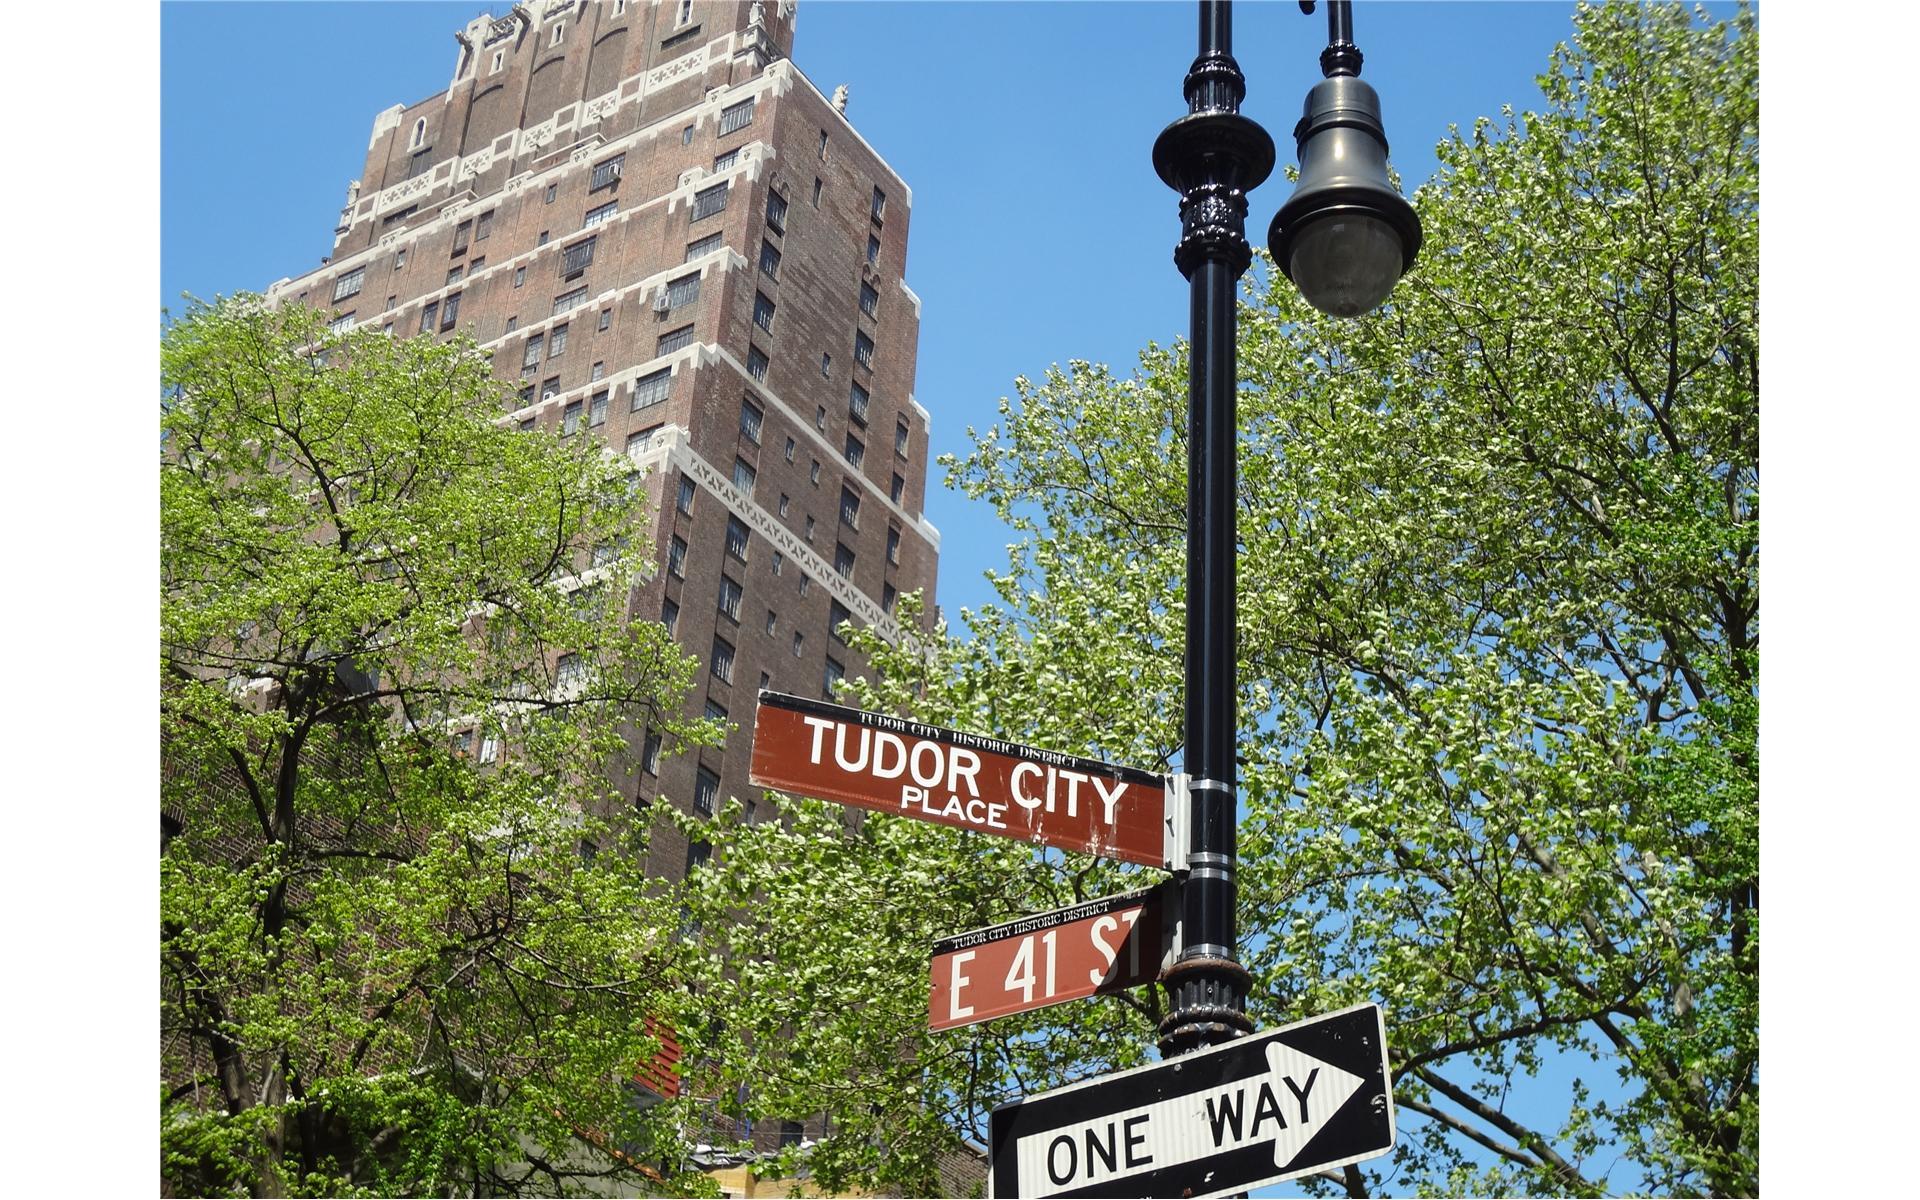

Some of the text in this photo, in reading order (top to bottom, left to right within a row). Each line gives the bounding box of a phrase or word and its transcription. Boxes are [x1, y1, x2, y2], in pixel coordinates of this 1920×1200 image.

[804, 716, 1129, 825] TUDOR CITY
[859, 712, 1078, 768] TUDOR CITY HISTORIC DISTRICT
[901, 785, 1008, 829] PLACE
[950, 907, 1147, 1020] E 41 ST
[952, 901, 1110, 949] TUDOR CITY HISTORIC DISTRICT
[1047, 1067, 1321, 1187] ONE WAY
